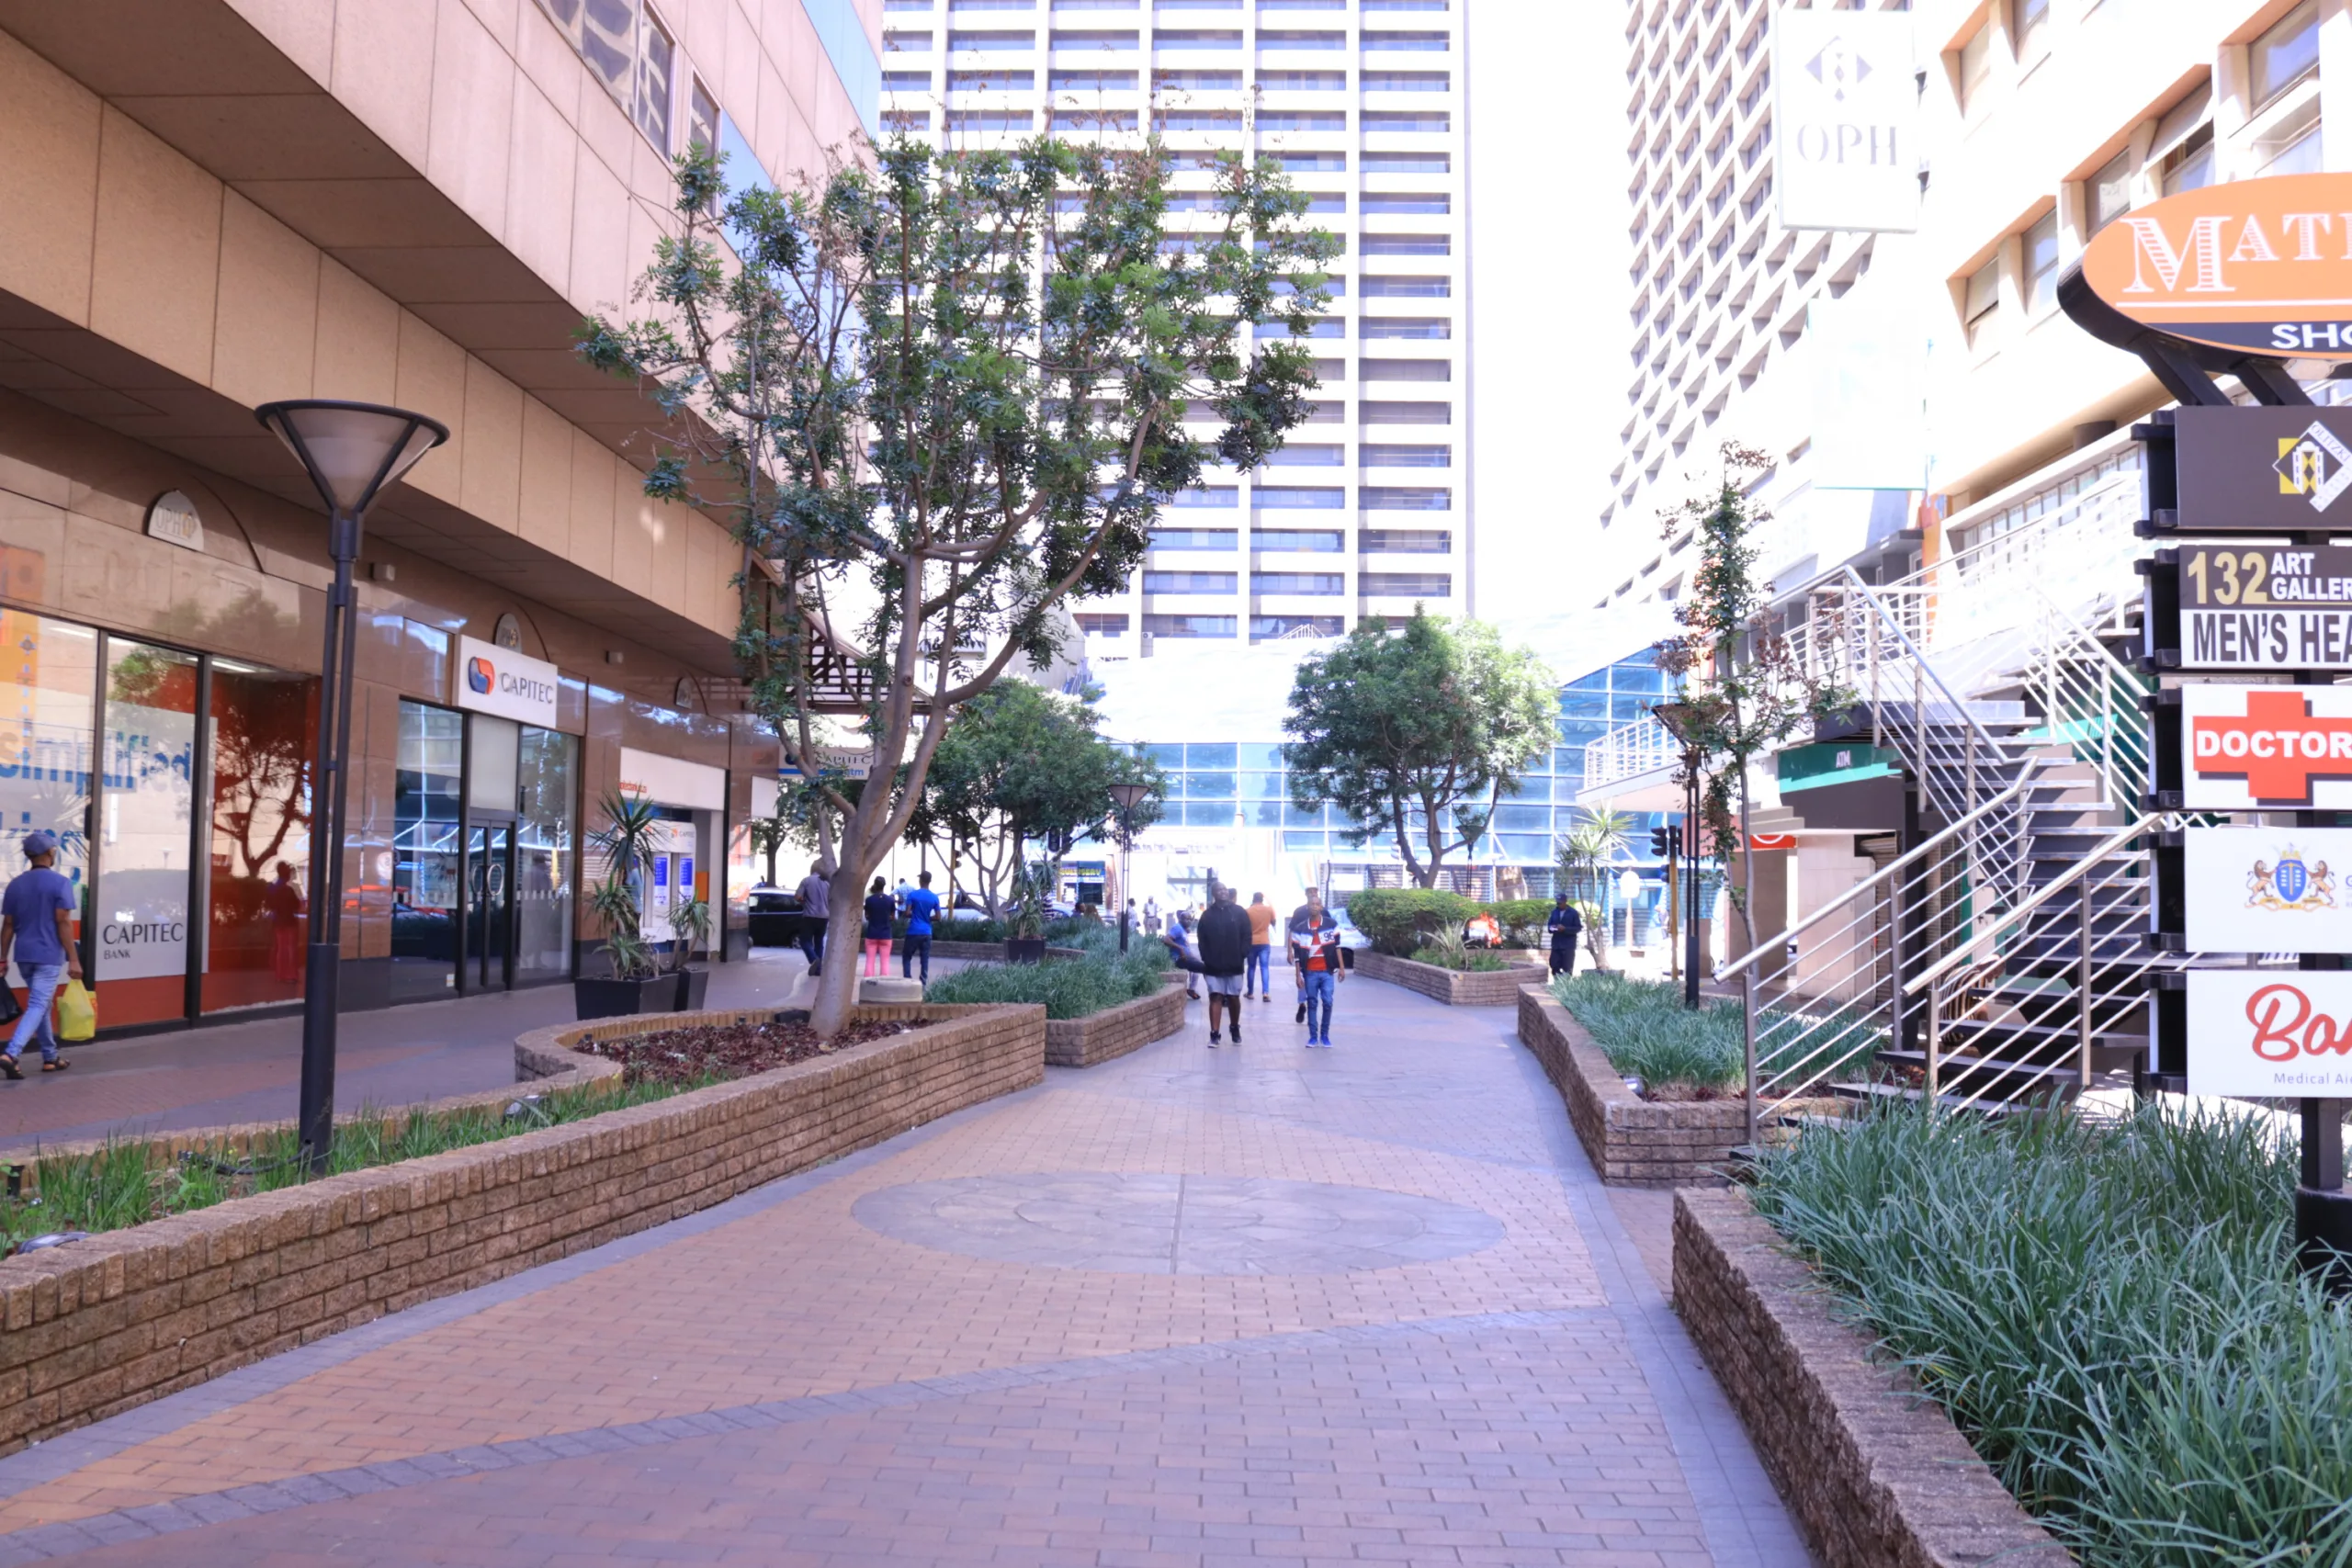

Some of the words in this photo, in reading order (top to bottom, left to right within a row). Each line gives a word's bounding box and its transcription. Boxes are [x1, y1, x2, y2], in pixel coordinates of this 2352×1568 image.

[1797, 123, 1897, 166] OPH
[2270, 553, 2315, 575] ART
[2188, 551, 2267, 605] 132
[2193, 613, 2289, 663] MEN'S
[501, 672, 553, 704] CAPITEC
[2197, 729, 2352, 759] DOCTOR
[817, 755, 871, 765] APITEC
[1835, 750, 1850, 769] ATM
[103, 922, 184, 944] CAPITEC
[103, 949, 130, 960] BANK
[2274, 1073, 2329, 1085] Medical
